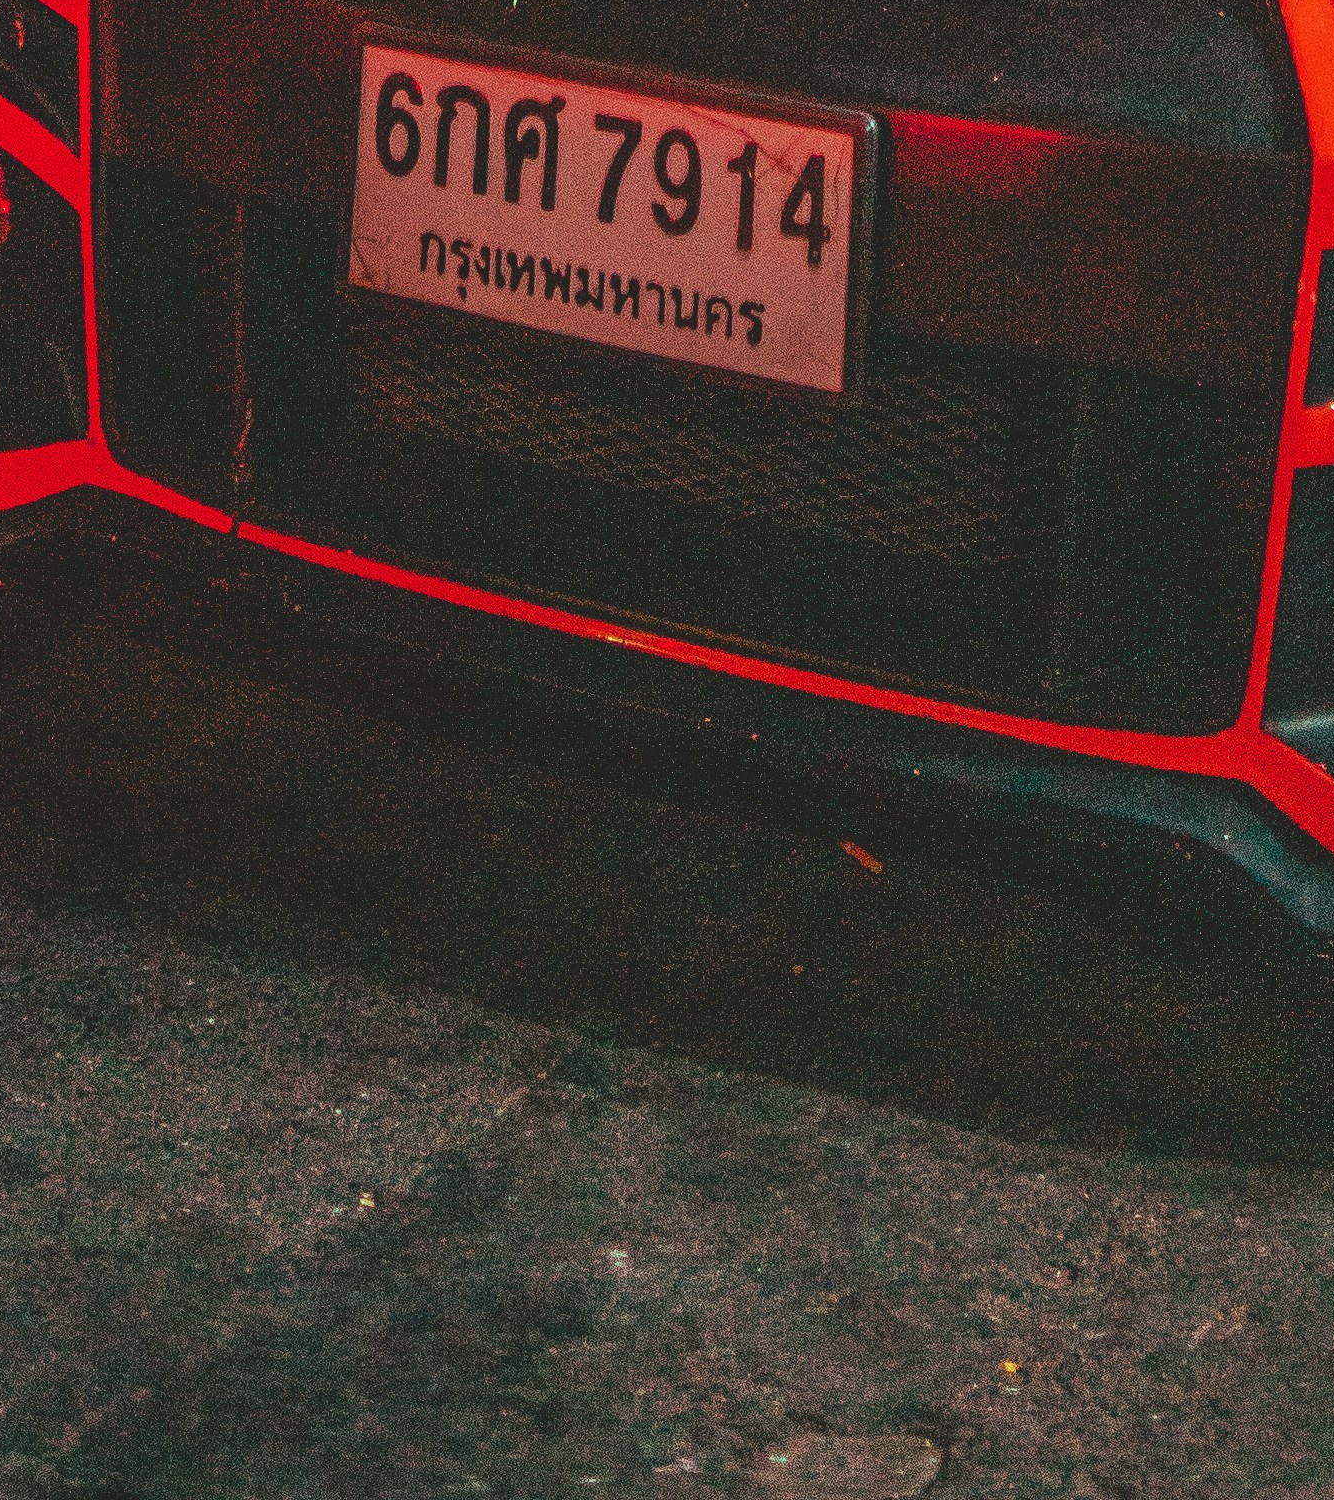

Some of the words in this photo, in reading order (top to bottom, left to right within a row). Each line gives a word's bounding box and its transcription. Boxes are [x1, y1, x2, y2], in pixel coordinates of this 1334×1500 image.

[375, 71, 566, 211] 6กศ
[594, 114, 831, 267] 7914
[420, 229, 766, 346] กรุงเทพมหานคร
